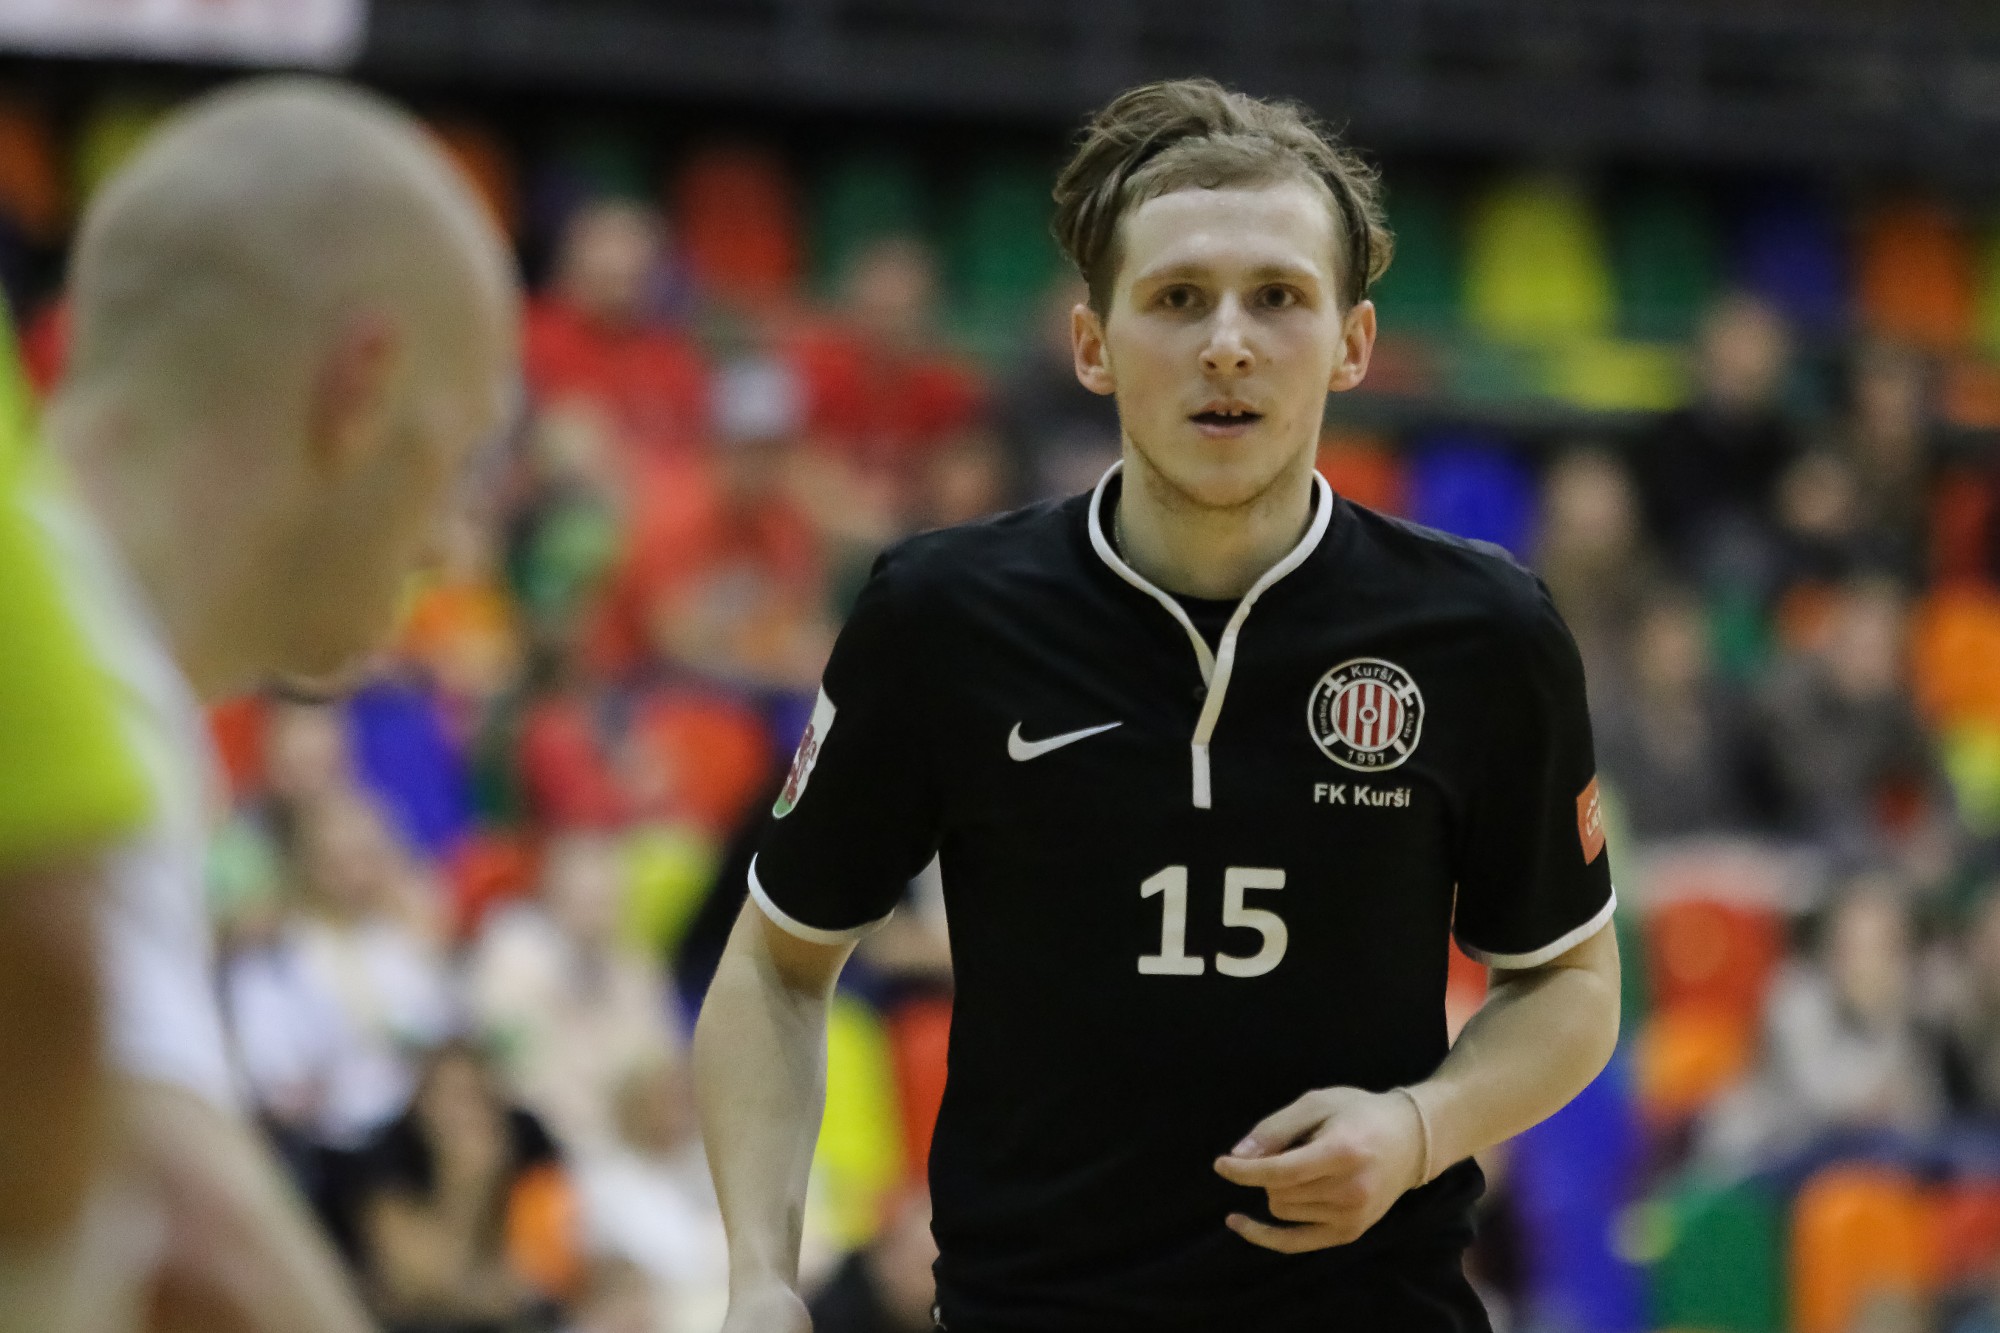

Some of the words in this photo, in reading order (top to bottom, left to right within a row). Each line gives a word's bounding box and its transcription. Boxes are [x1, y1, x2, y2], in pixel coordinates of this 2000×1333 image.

[1350, 666, 1394, 682] Kurši
[1347, 750, 1385, 765] 1997
[1314, 783, 1347, 804] FK
[1354, 785, 1412, 807] Kurši
[1138, 865, 1288, 978] 15
